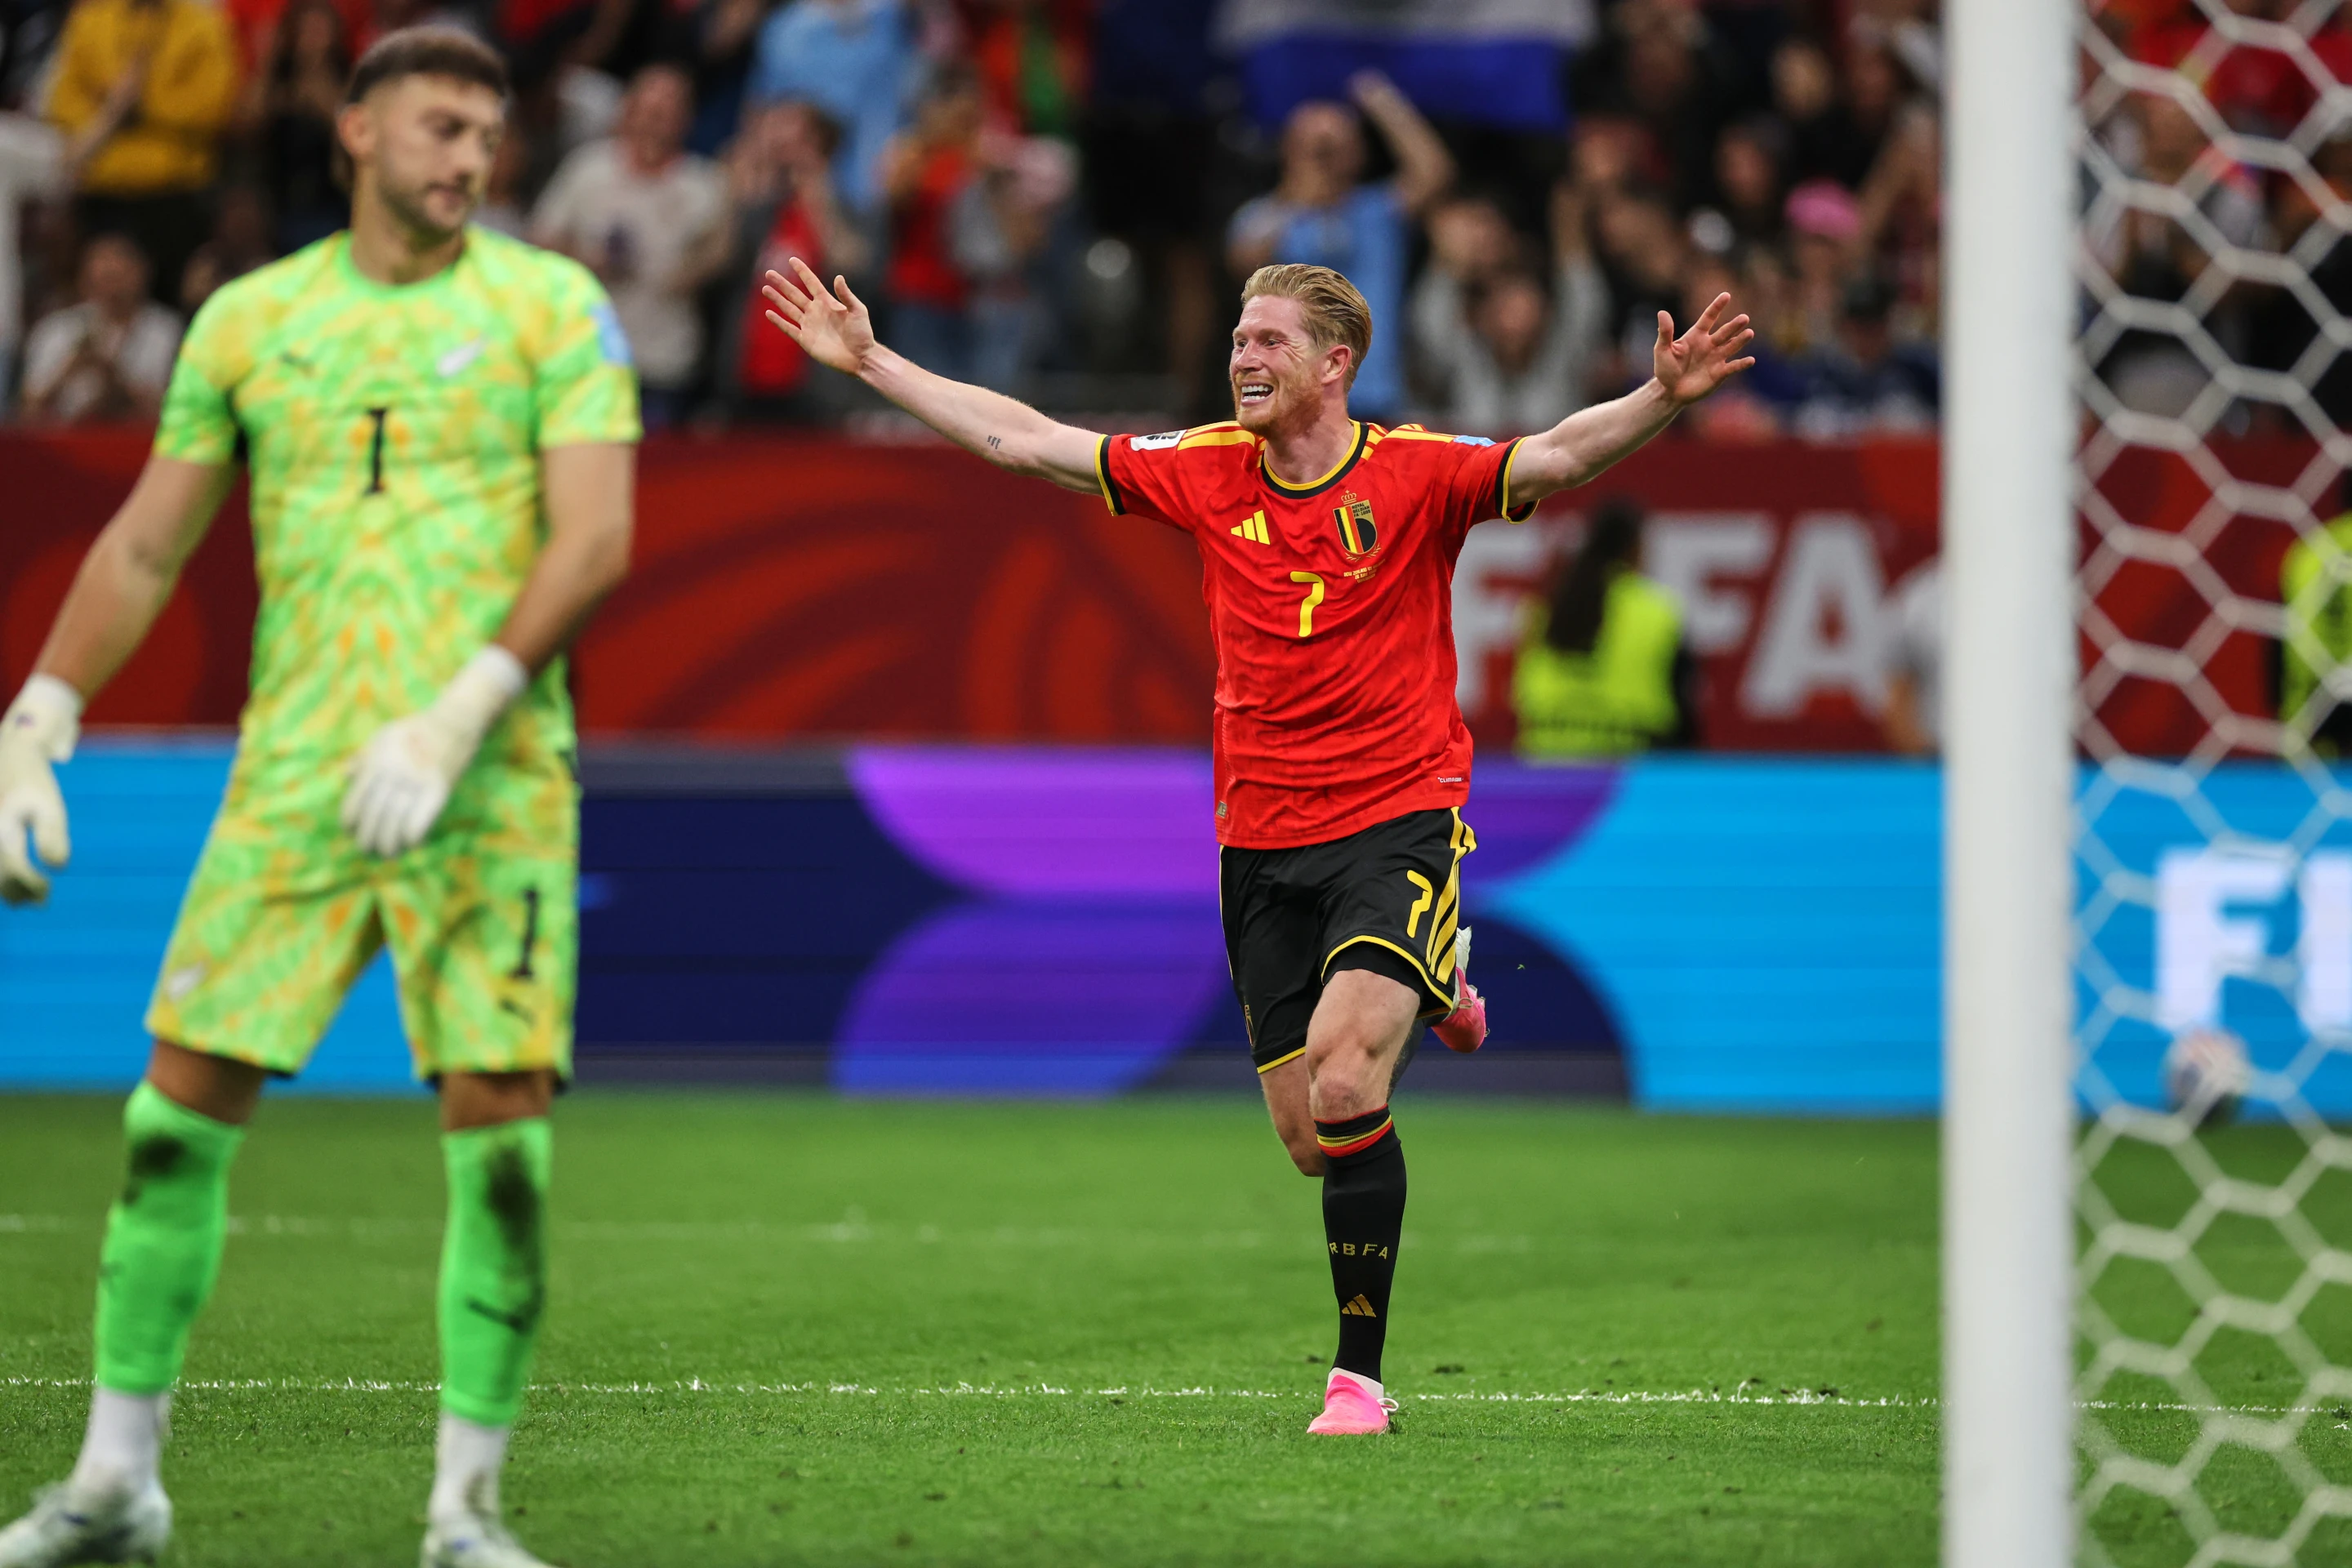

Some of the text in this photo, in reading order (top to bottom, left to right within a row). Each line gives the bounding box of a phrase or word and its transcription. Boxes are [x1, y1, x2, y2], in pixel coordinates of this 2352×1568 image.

[367, 408, 388, 495] 1
[1290, 571, 1325, 637] 7
[1451, 514, 1895, 720] FFA
[508, 887, 541, 982] 1
[1406, 870, 1433, 938] 7
[1329, 1241, 1388, 1259] RBFA
